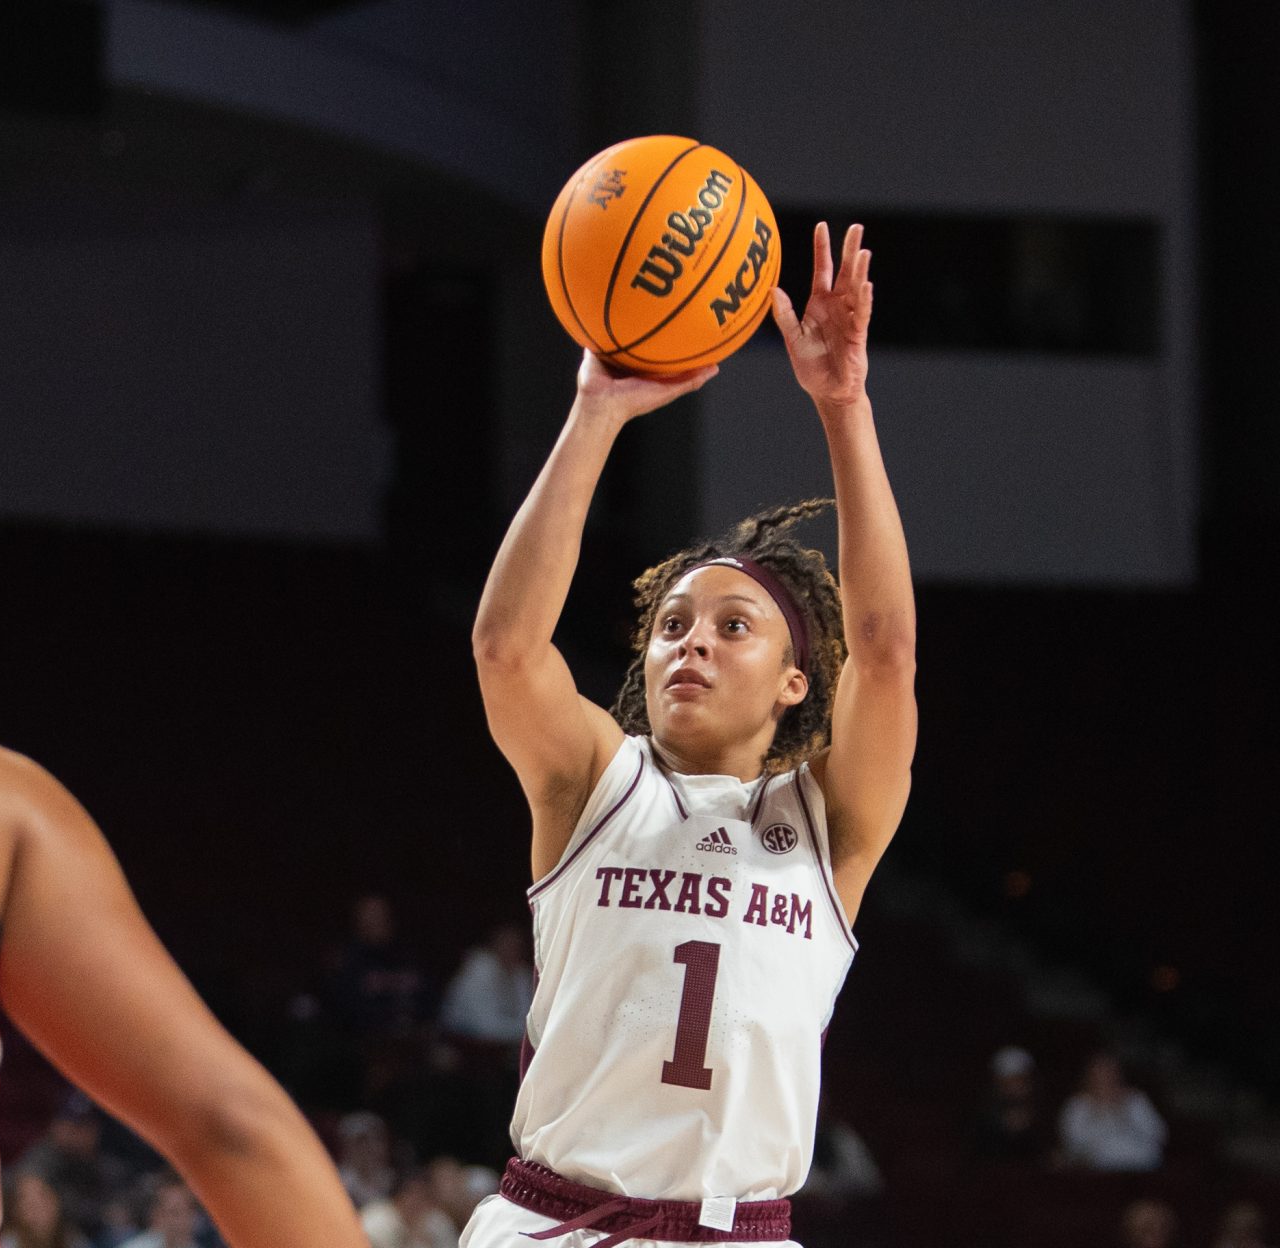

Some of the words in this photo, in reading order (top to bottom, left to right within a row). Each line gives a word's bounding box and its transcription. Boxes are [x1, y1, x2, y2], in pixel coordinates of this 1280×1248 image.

[629, 168, 734, 298] Wilson
[709, 216, 772, 327] NCAA
[696, 841, 738, 856] adidas
[764, 825, 796, 852] SEC
[594, 866, 733, 919] TEXAS
[742, 882, 813, 940] A&M
[660, 939, 722, 1091] 1
